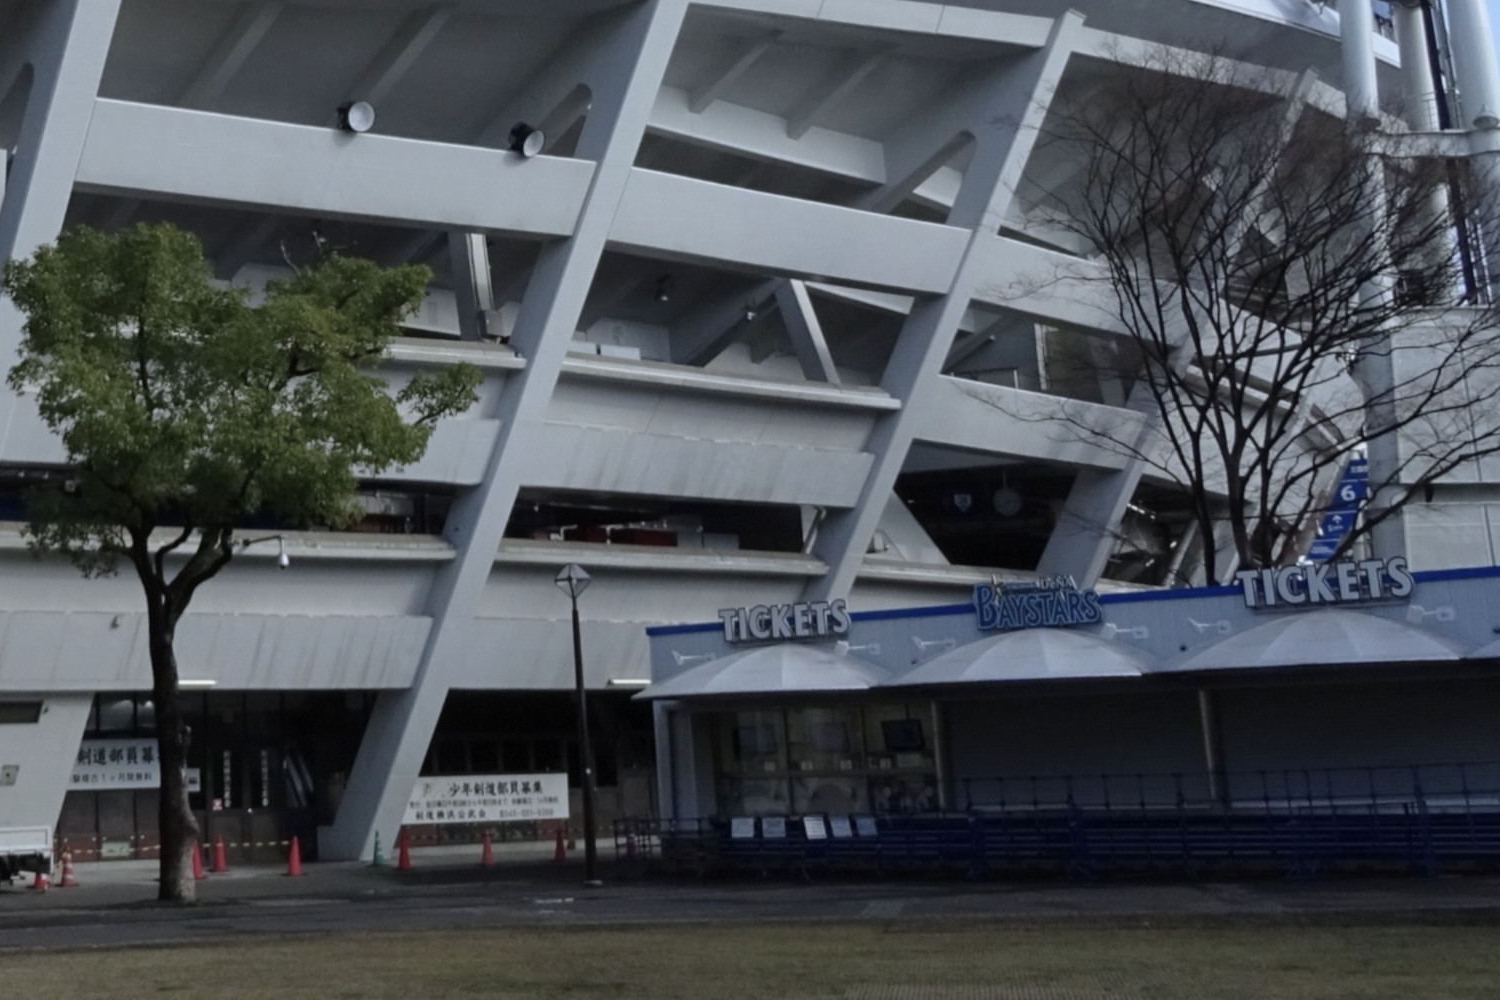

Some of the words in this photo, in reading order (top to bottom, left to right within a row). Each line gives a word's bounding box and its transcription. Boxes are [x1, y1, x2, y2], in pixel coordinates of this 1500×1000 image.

[1340, 484, 1356, 501] 6
[1039, 574, 1078, 590] DeNA
[1235, 556, 1414, 607] TICKETS
[718, 598, 850, 642] TICKETS
[78, 746, 160, 765] 剣道部員募
